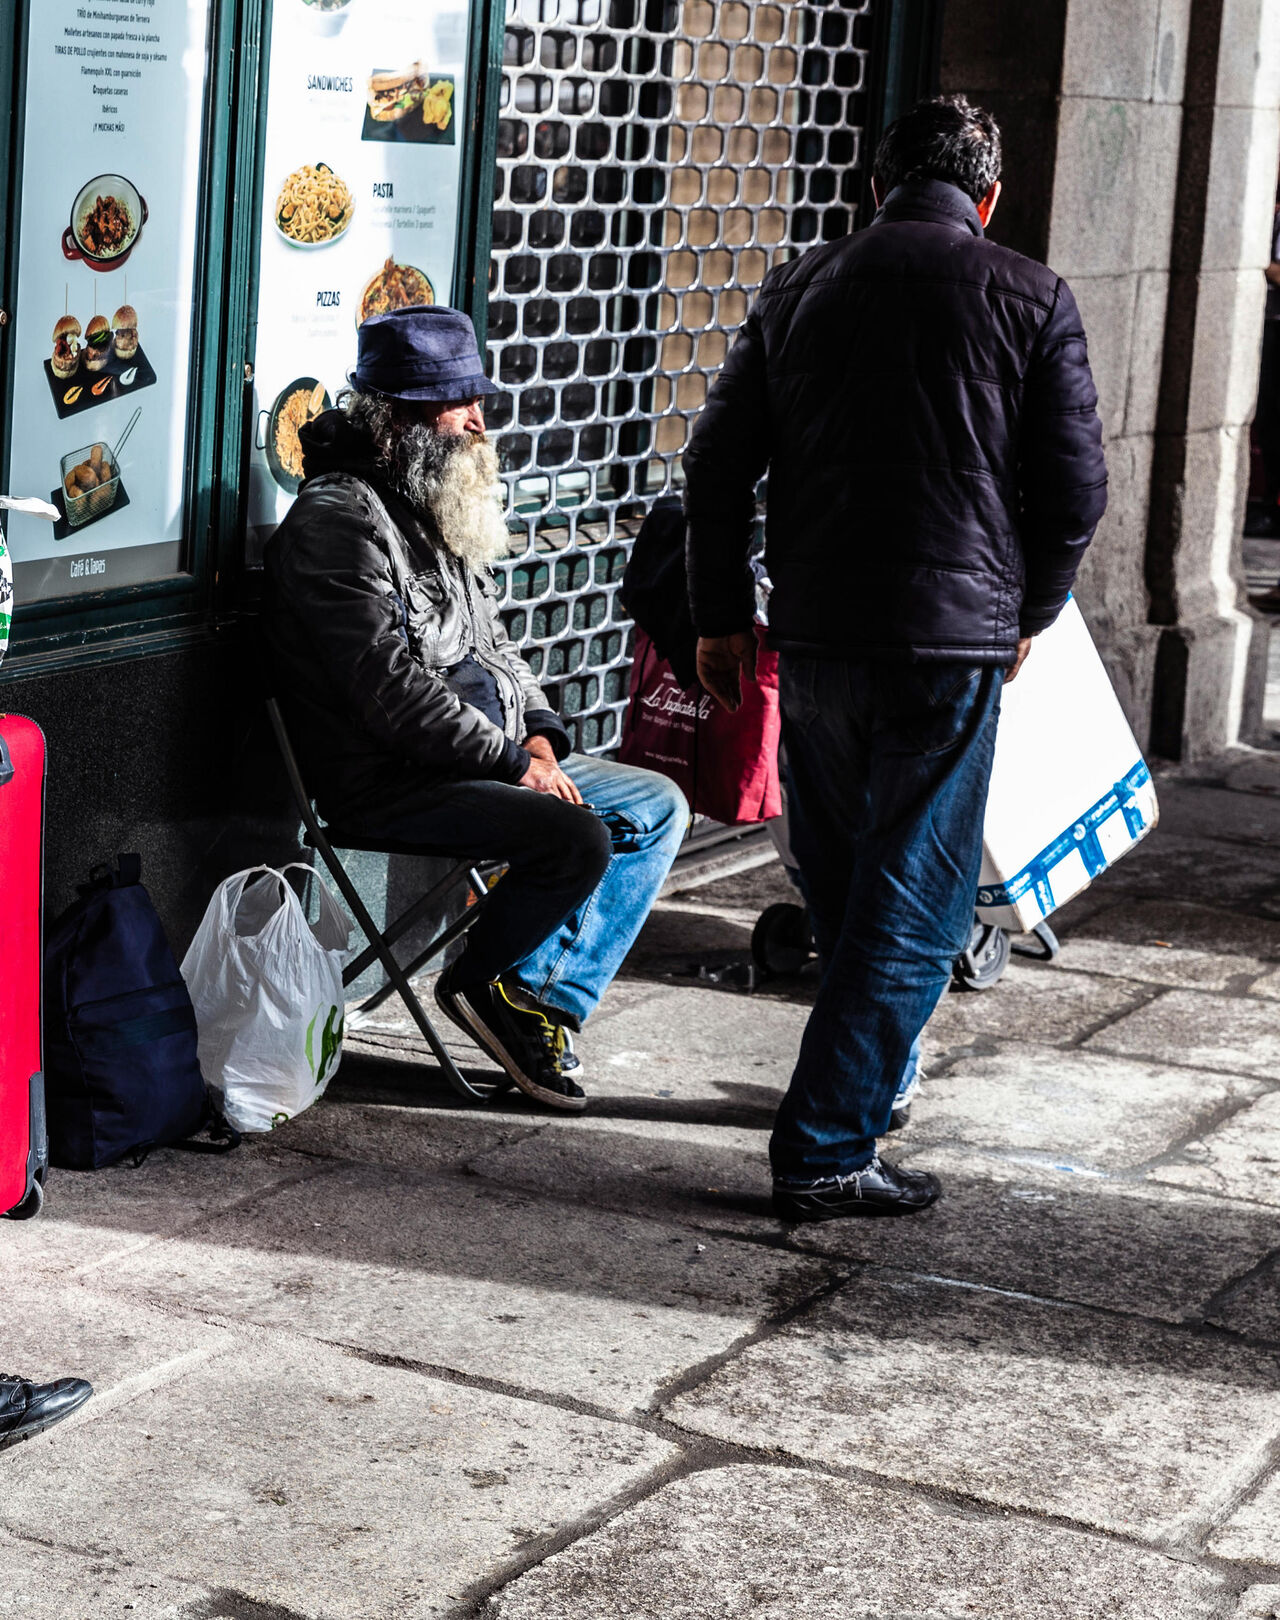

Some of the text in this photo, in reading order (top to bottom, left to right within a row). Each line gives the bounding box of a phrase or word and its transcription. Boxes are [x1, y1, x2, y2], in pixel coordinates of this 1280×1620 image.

[87, 10, 92, 18] de
[130, 14, 135, 22] de
[136, 14, 150, 23] Ternera
[64, 28, 81, 36] Molletes
[82, 29, 102, 38] artesanos
[126, 32, 137, 40] fresca
[146, 34, 160, 42] plancha
[55, 45, 66, 54] TIRAS
[68, 46, 73, 55] DE
[74, 47, 86, 56] POLLO
[136, 51, 140, 59] de
[93, 84, 113, 96] Croquetas
[307, 74, 353, 92] SANDWICHES
[98, 123, 114, 132] MUCHAS
[373, 183, 393, 198] PASTA
[317, 292, 340, 306] PIZZAS
[70, 558, 106, 578] Café & Tapas
[641, 683, 664, 708] La
